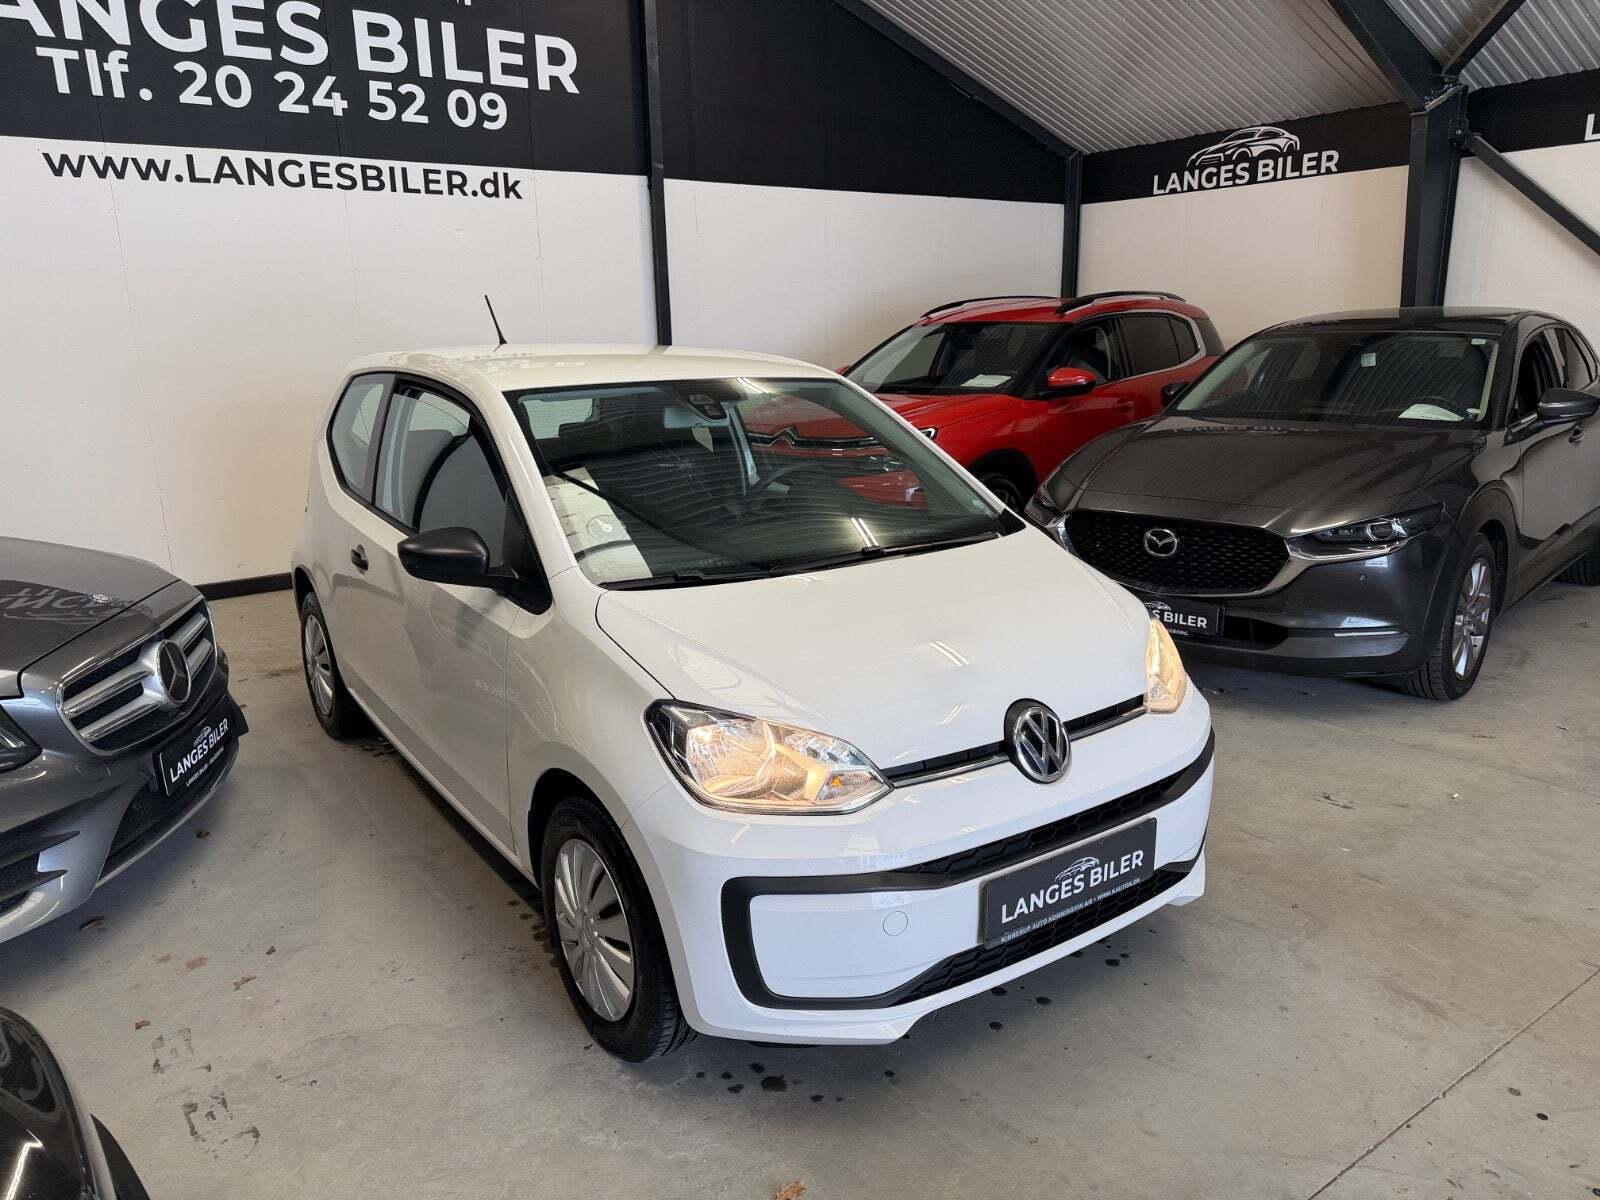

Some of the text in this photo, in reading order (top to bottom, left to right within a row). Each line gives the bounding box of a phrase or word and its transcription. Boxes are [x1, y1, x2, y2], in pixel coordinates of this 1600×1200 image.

[352, 10, 580, 94] BILER
[36, 46, 508, 130] Tlf. 20 24 52 09
[42, 152, 523, 200] www.LANGESBILER.dk
[1152, 150, 1340, 195] LANGES BILER
[1163, 611, 1208, 629] BILER
[169, 739, 209, 783] LANGES
[208, 717, 229, 749] BILER
[1001, 849, 1144, 924] LANGES BILER
[1032, 918, 1048, 931] AUTO
